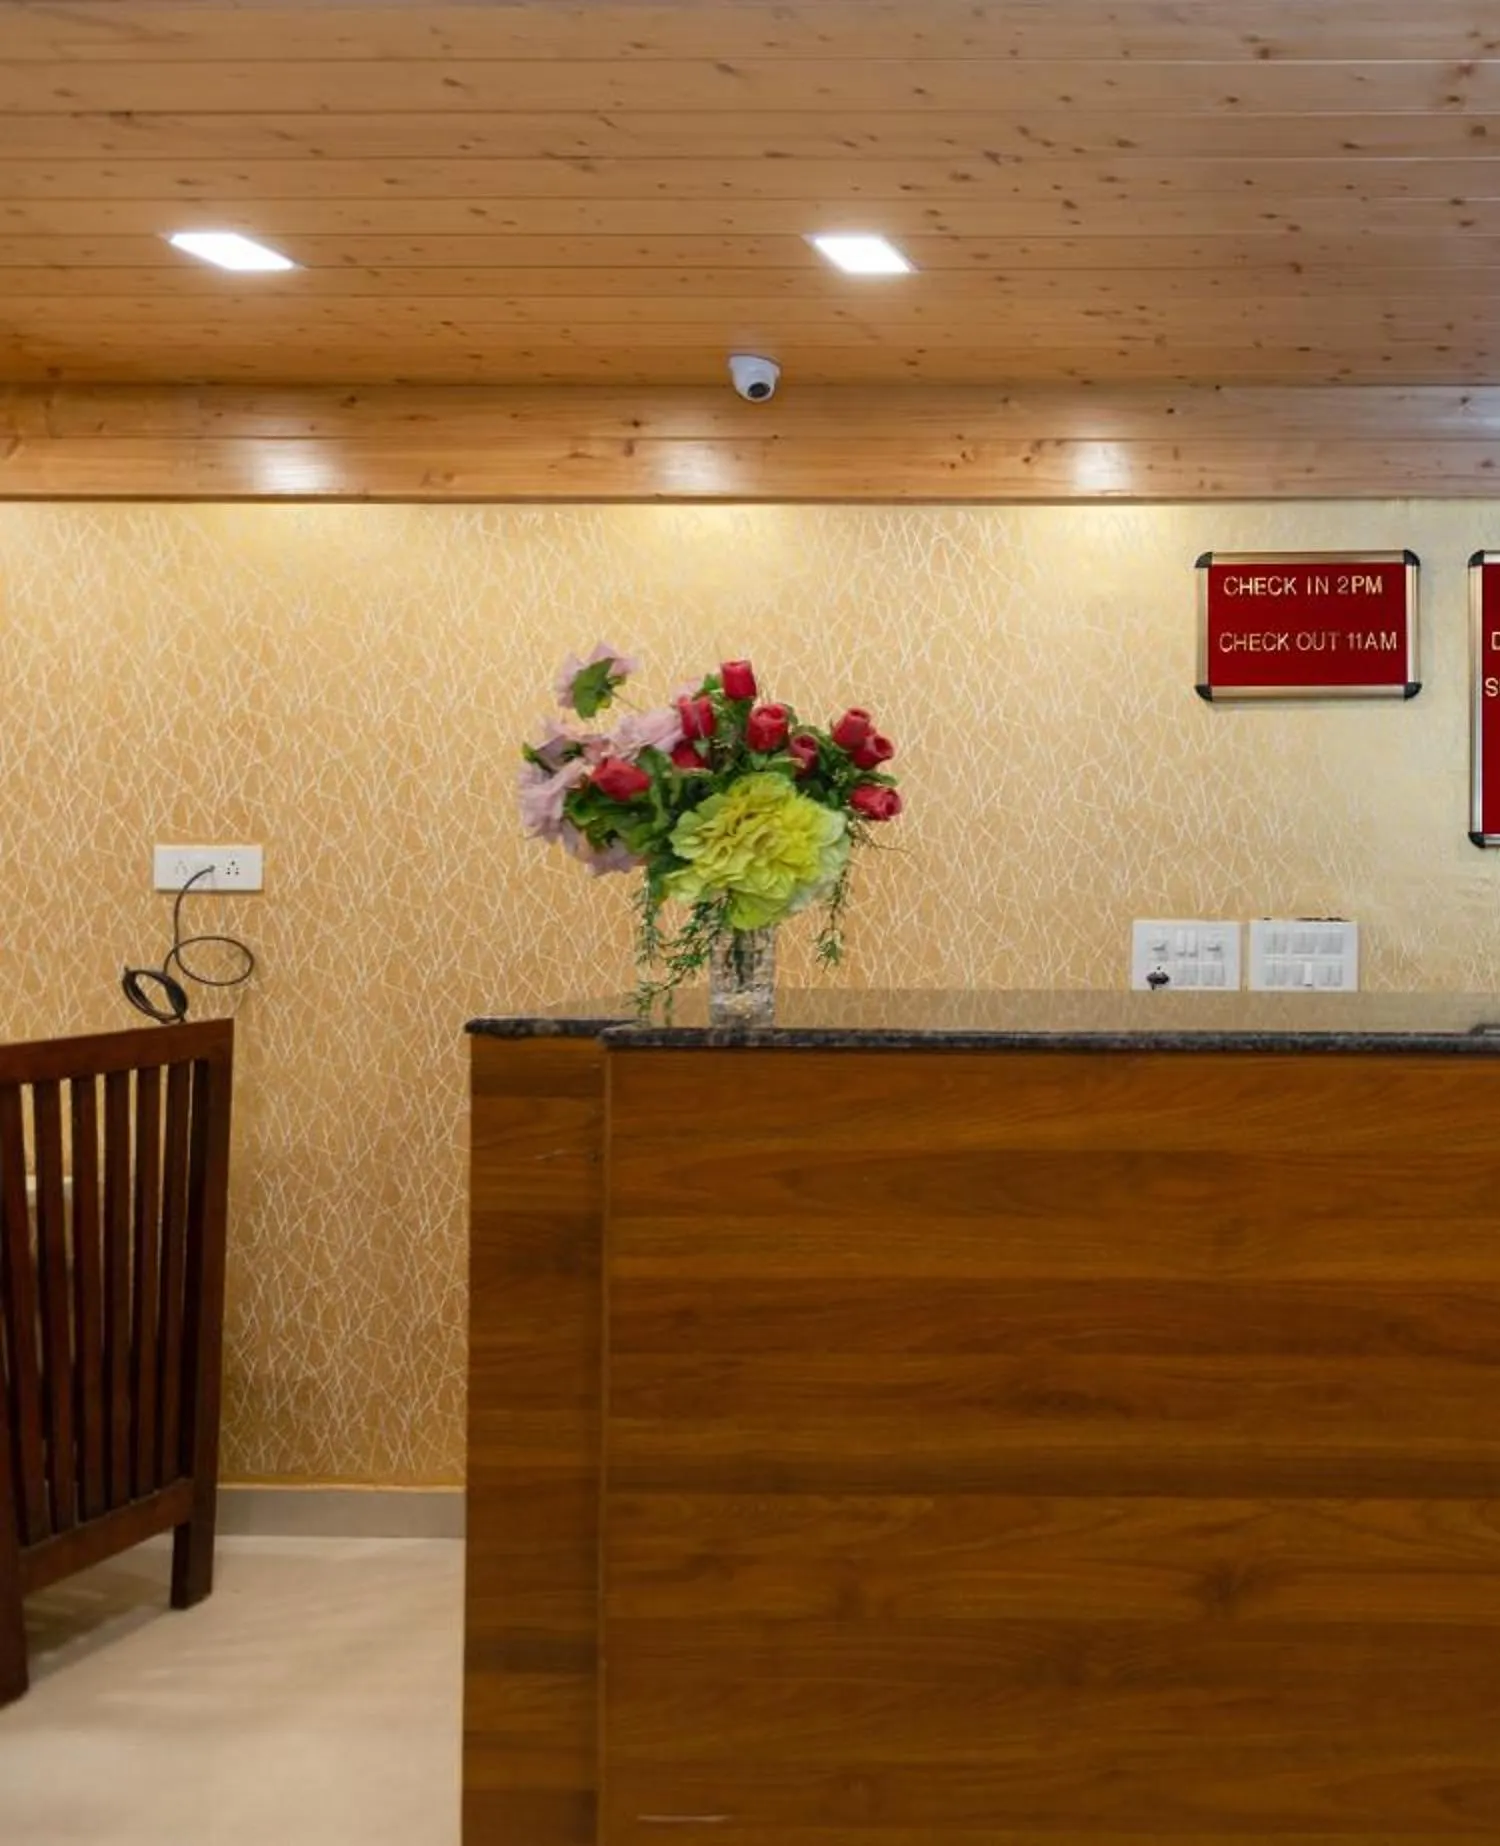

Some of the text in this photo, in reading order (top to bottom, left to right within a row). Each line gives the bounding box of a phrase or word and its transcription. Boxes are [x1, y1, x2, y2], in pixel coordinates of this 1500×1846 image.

[1223, 575, 1383, 596] CHECK IN 2PM
[1219, 631, 1397, 652] CHECK OUT 11AM
